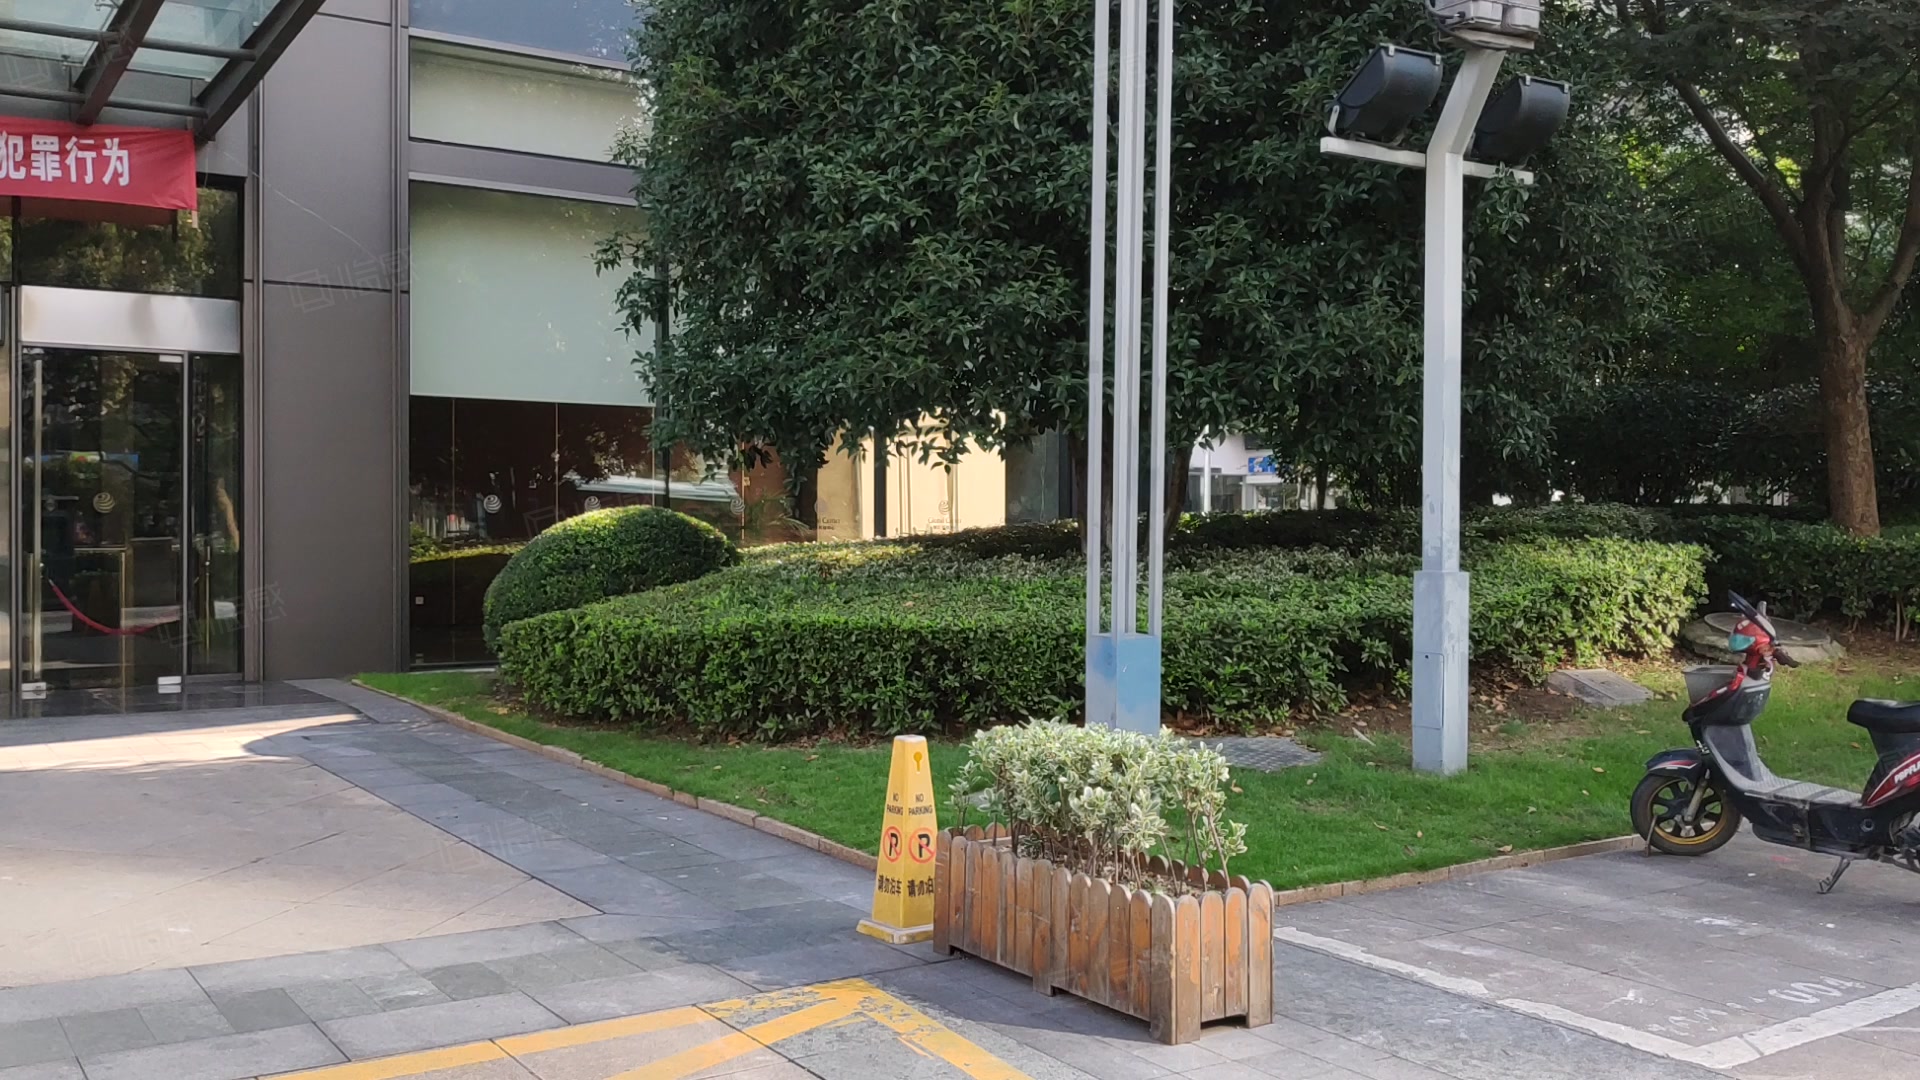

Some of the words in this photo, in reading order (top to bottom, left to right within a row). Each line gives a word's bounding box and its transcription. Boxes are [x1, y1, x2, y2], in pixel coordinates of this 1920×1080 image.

[0, 131, 130, 186] 犯罪行为
[915, 793, 925, 802] NO
[886, 804, 903, 816] PARKING
[908, 805, 933, 816] PARKING
[878, 873, 902, 897] 请勿泊车
